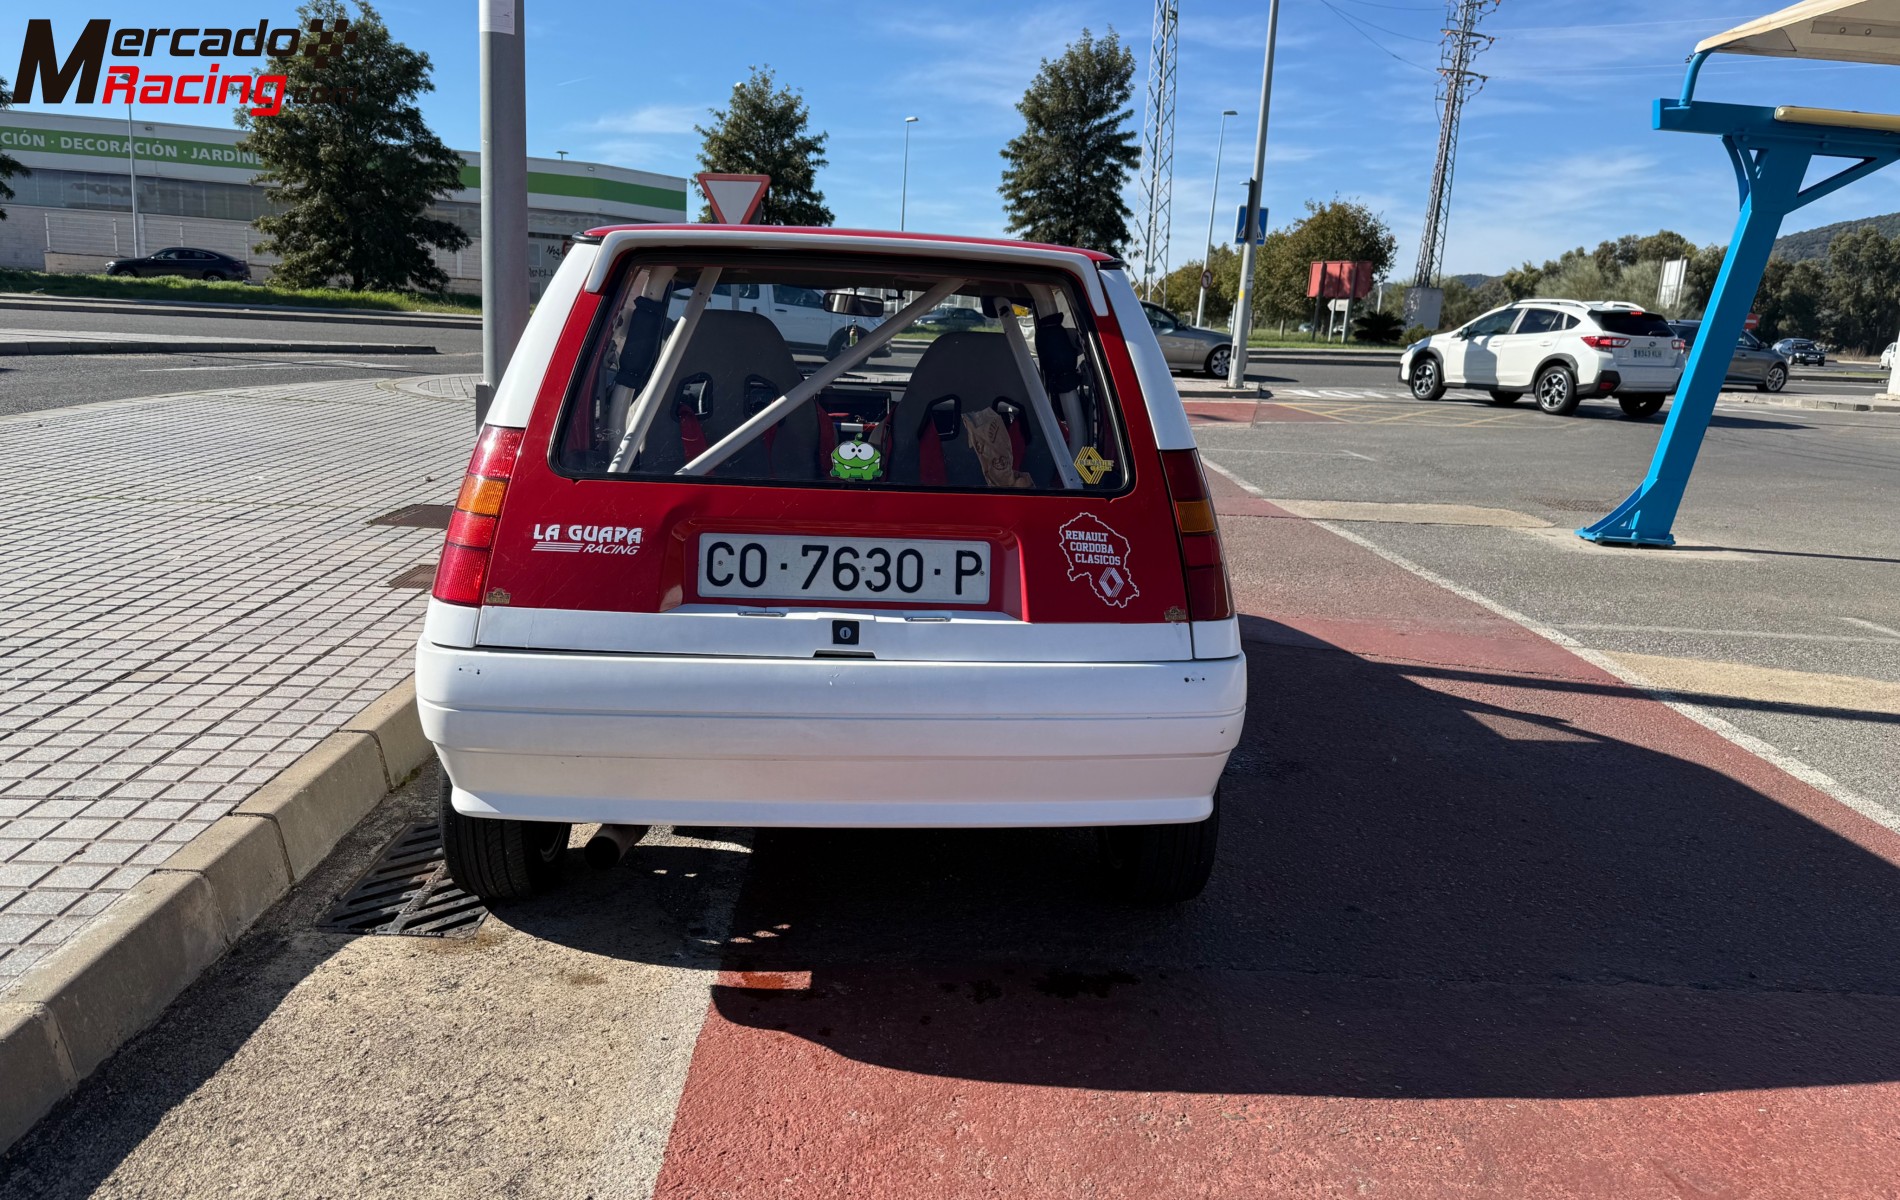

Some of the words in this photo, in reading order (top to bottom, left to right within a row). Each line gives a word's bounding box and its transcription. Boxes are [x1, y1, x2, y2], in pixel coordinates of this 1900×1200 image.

[60, 136, 178, 158] DECORACIÓN
[190, 147, 265, 166] JARDINE
[533, 523, 561, 542] LA
[567, 525, 643, 545] GUAPA
[1065, 529, 1109, 542] RENAULT
[582, 543, 641, 556] RACING
[1070, 541, 1115, 554] CORDOBA
[1075, 553, 1121, 566] CLASICOS
[706, 541, 768, 589] CO
[801, 544, 924, 594] 7630
[954, 549, 983, 595] P
